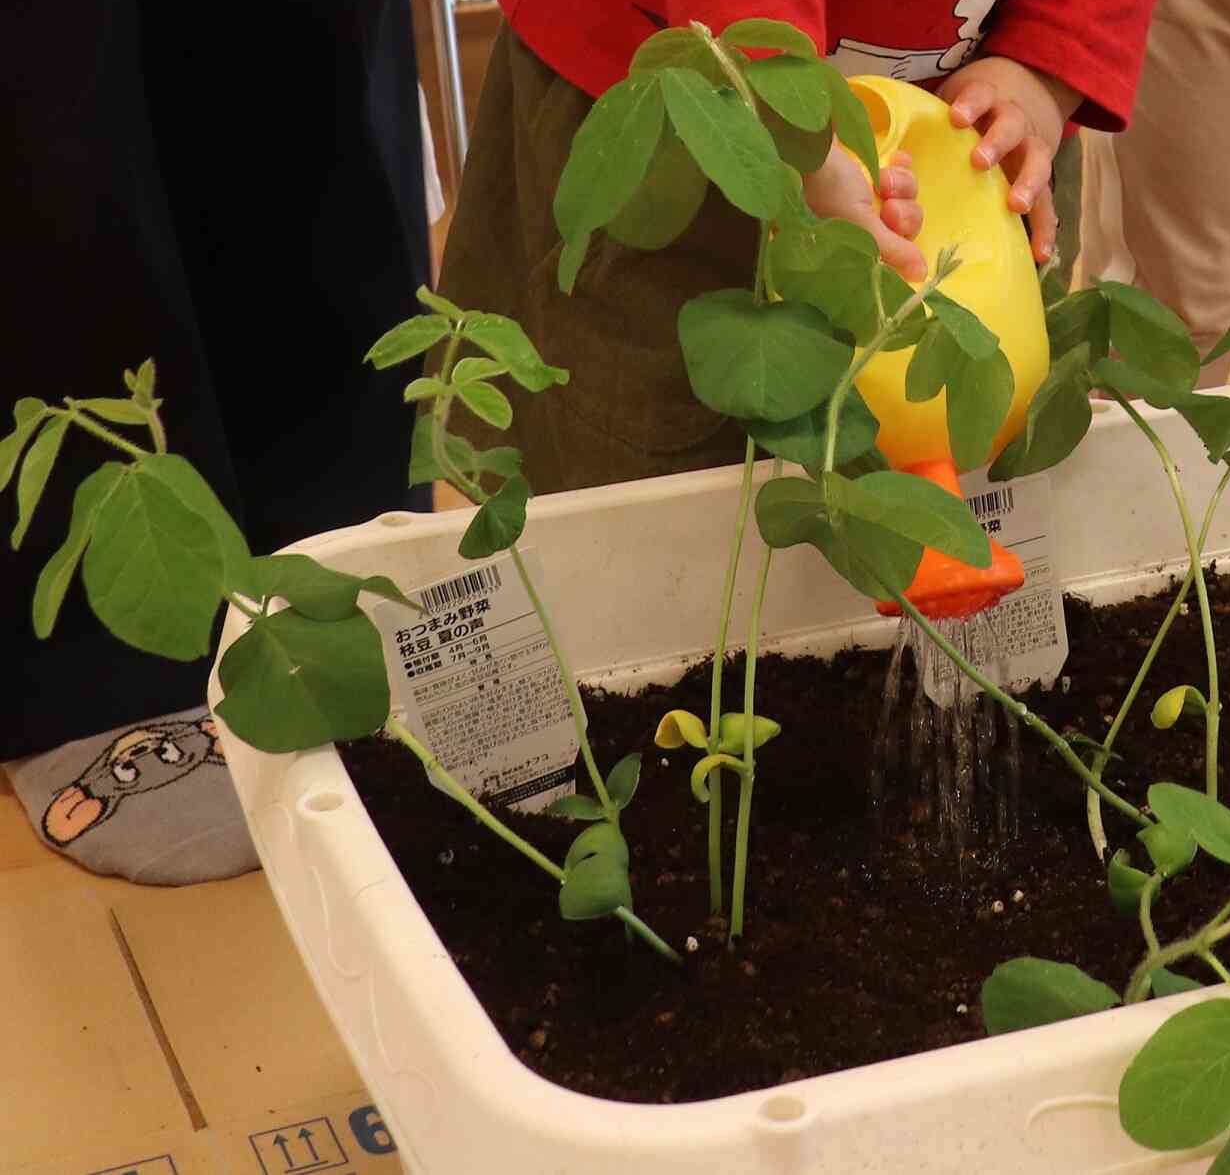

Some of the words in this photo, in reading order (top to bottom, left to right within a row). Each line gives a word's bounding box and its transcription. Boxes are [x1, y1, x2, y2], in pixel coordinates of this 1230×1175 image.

[395, 598, 491, 643] おつまみ野菜
[400, 636, 433, 658] 枝豆
[438, 617, 484, 645] 夏の声
